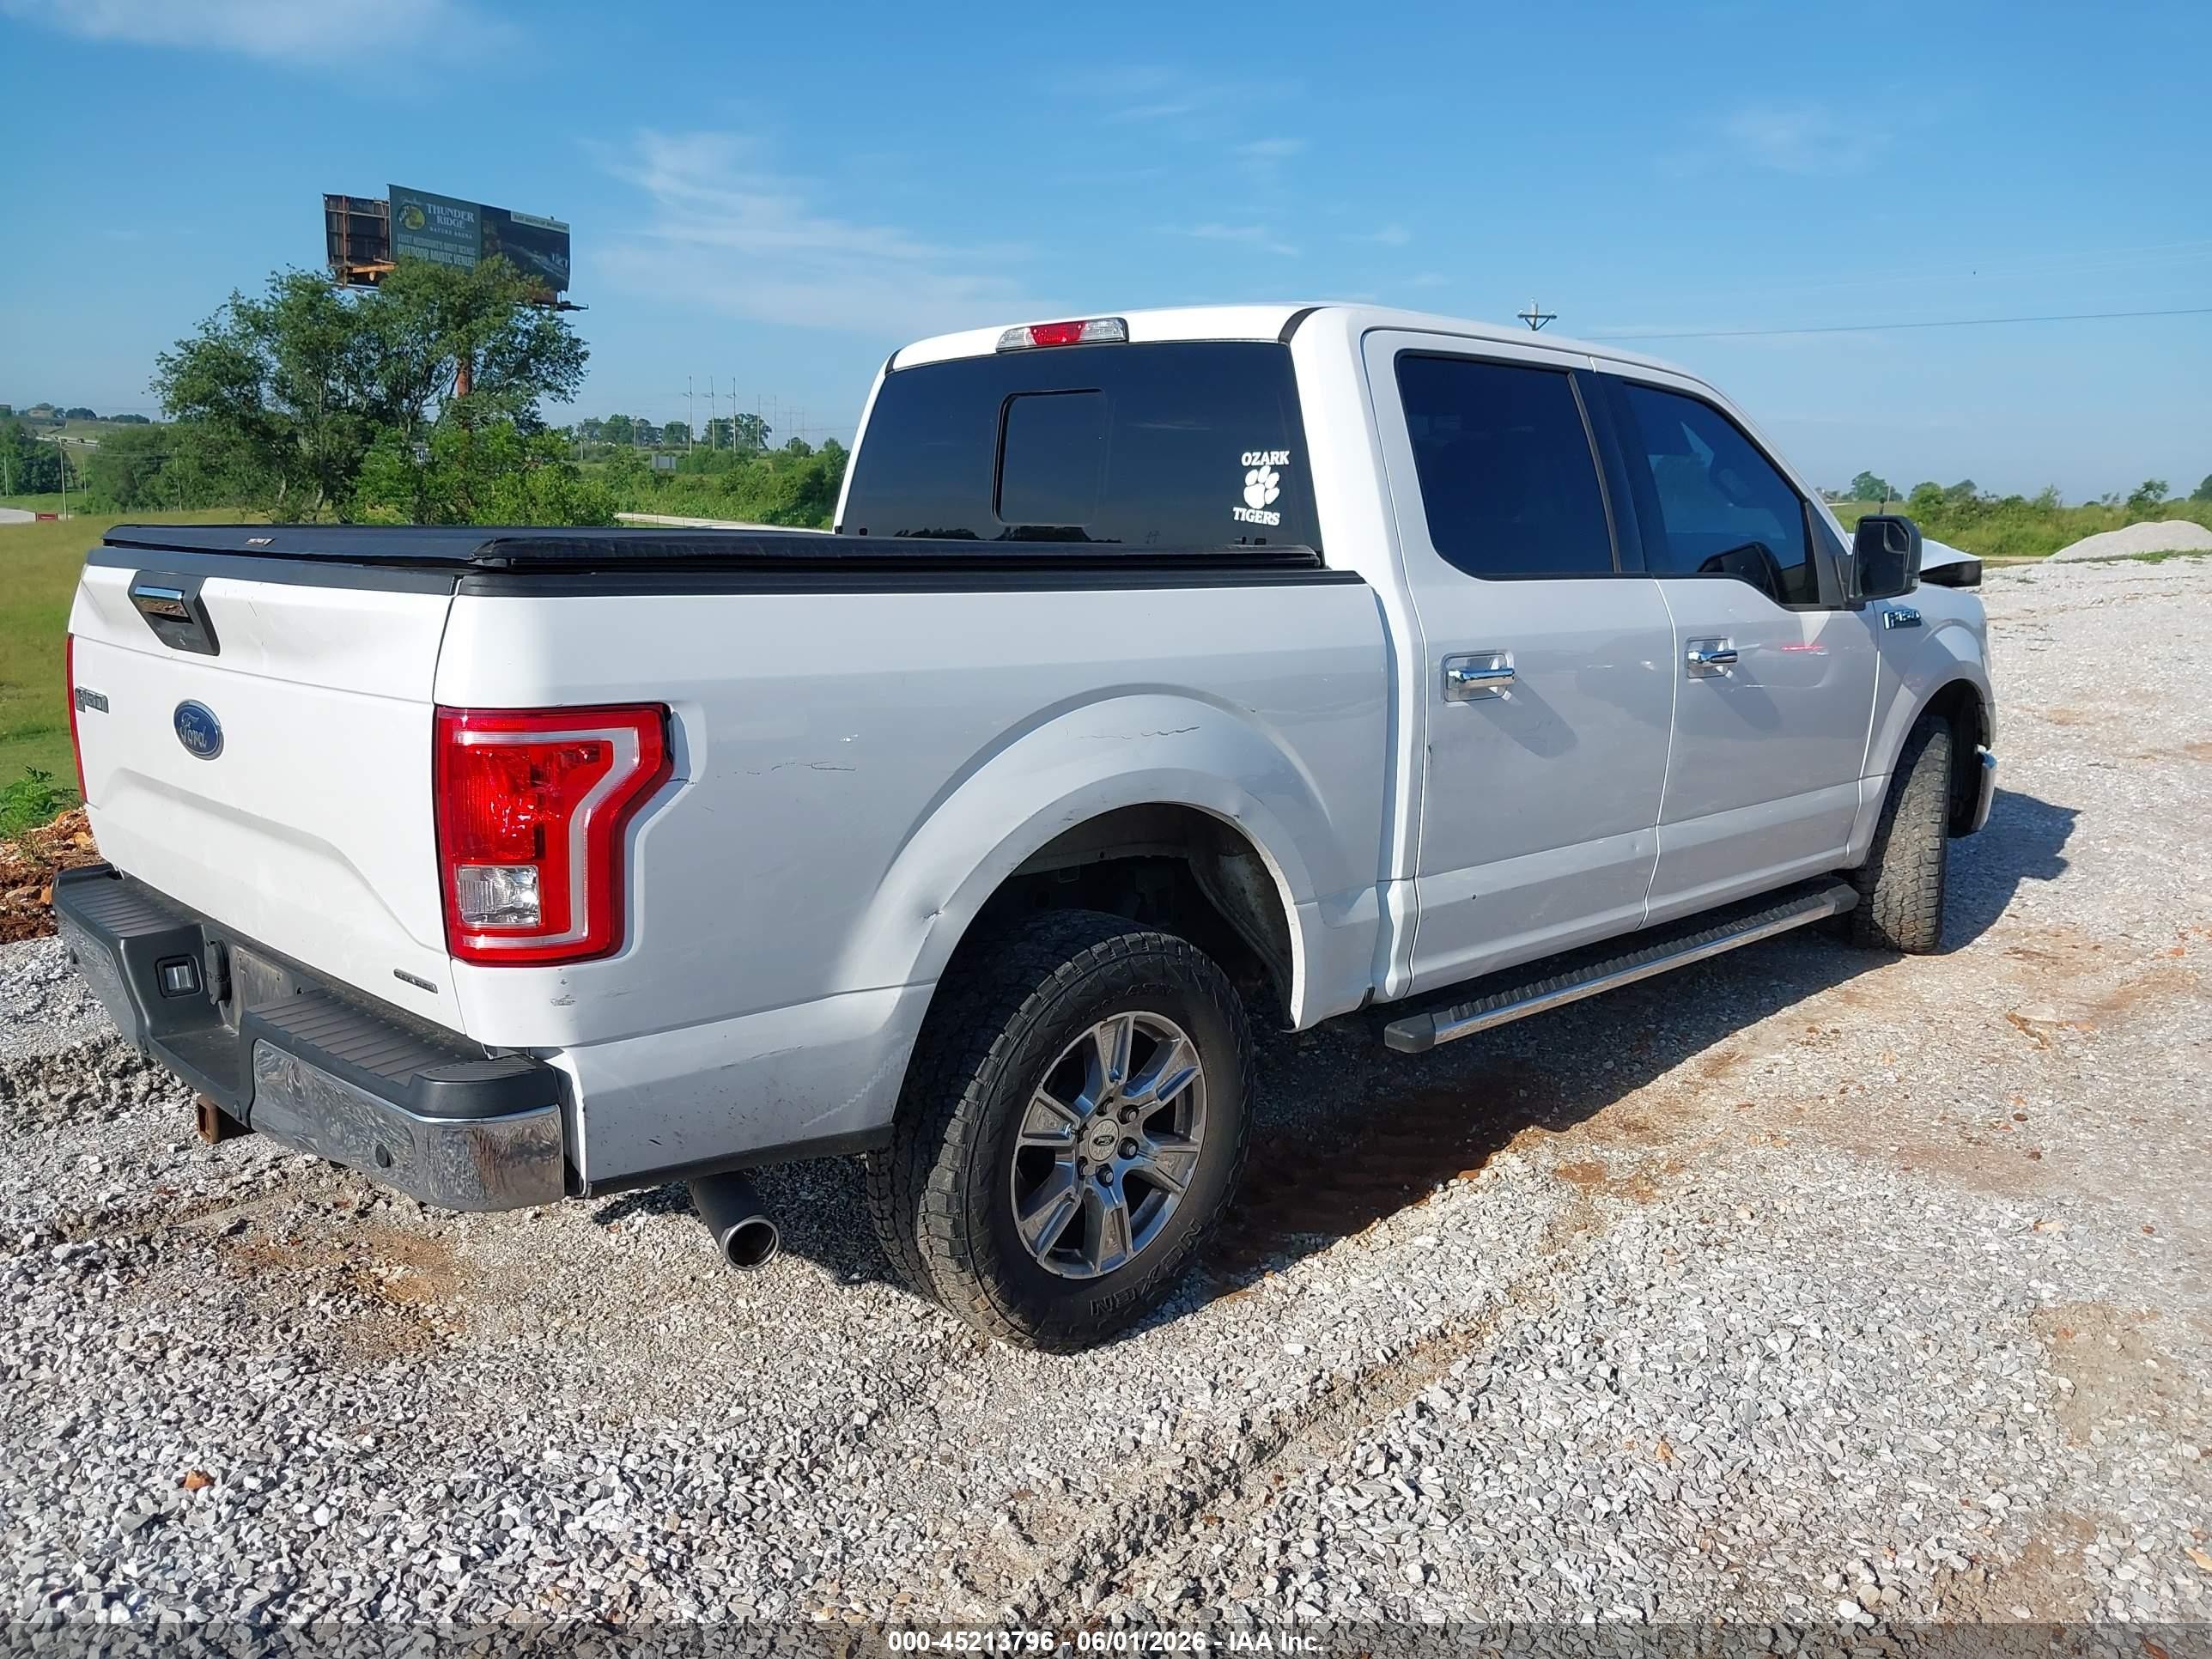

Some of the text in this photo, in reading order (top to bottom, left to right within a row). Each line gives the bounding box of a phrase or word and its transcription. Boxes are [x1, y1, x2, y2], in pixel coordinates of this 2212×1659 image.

[425, 203, 475, 223] THUNDER
[436, 215, 465, 228] RIDGE
[397, 243, 429, 262] OUTDOOR
[430, 250, 453, 264] MUSIC
[1241, 450, 1291, 466] OZARK
[1232, 507, 1280, 526] TIGERS
[180, 711, 208, 750] Ford
